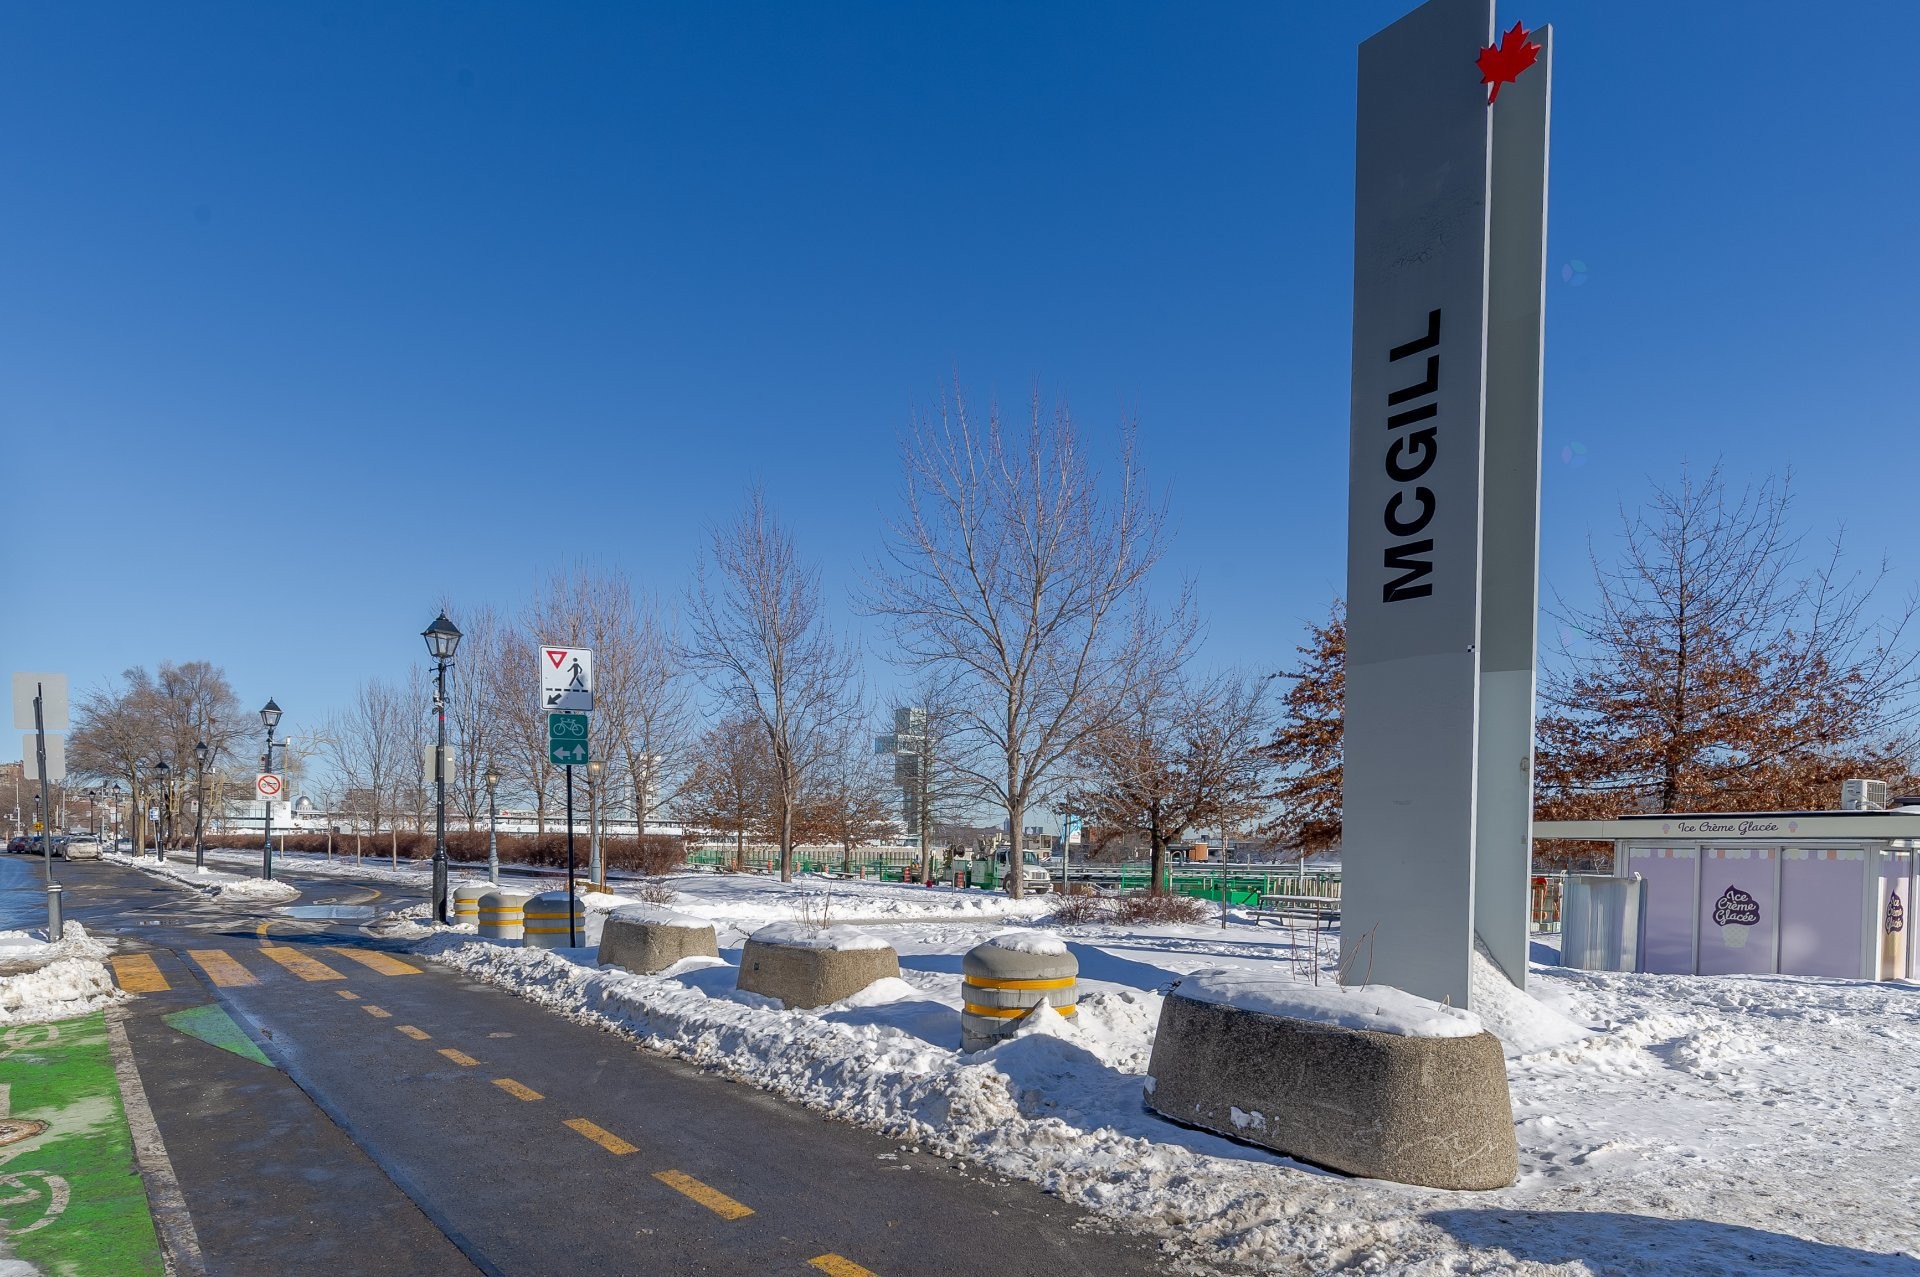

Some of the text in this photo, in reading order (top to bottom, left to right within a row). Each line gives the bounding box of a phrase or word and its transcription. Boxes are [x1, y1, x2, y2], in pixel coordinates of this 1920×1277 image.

[1382, 308, 1442, 604] MCGILL
[1678, 820, 1779, 836] Ice Crème Glacée
[1717, 897, 1757, 911] Crème
[1726, 890, 1749, 902] Ice
[1715, 909, 1757, 925] Glacée
